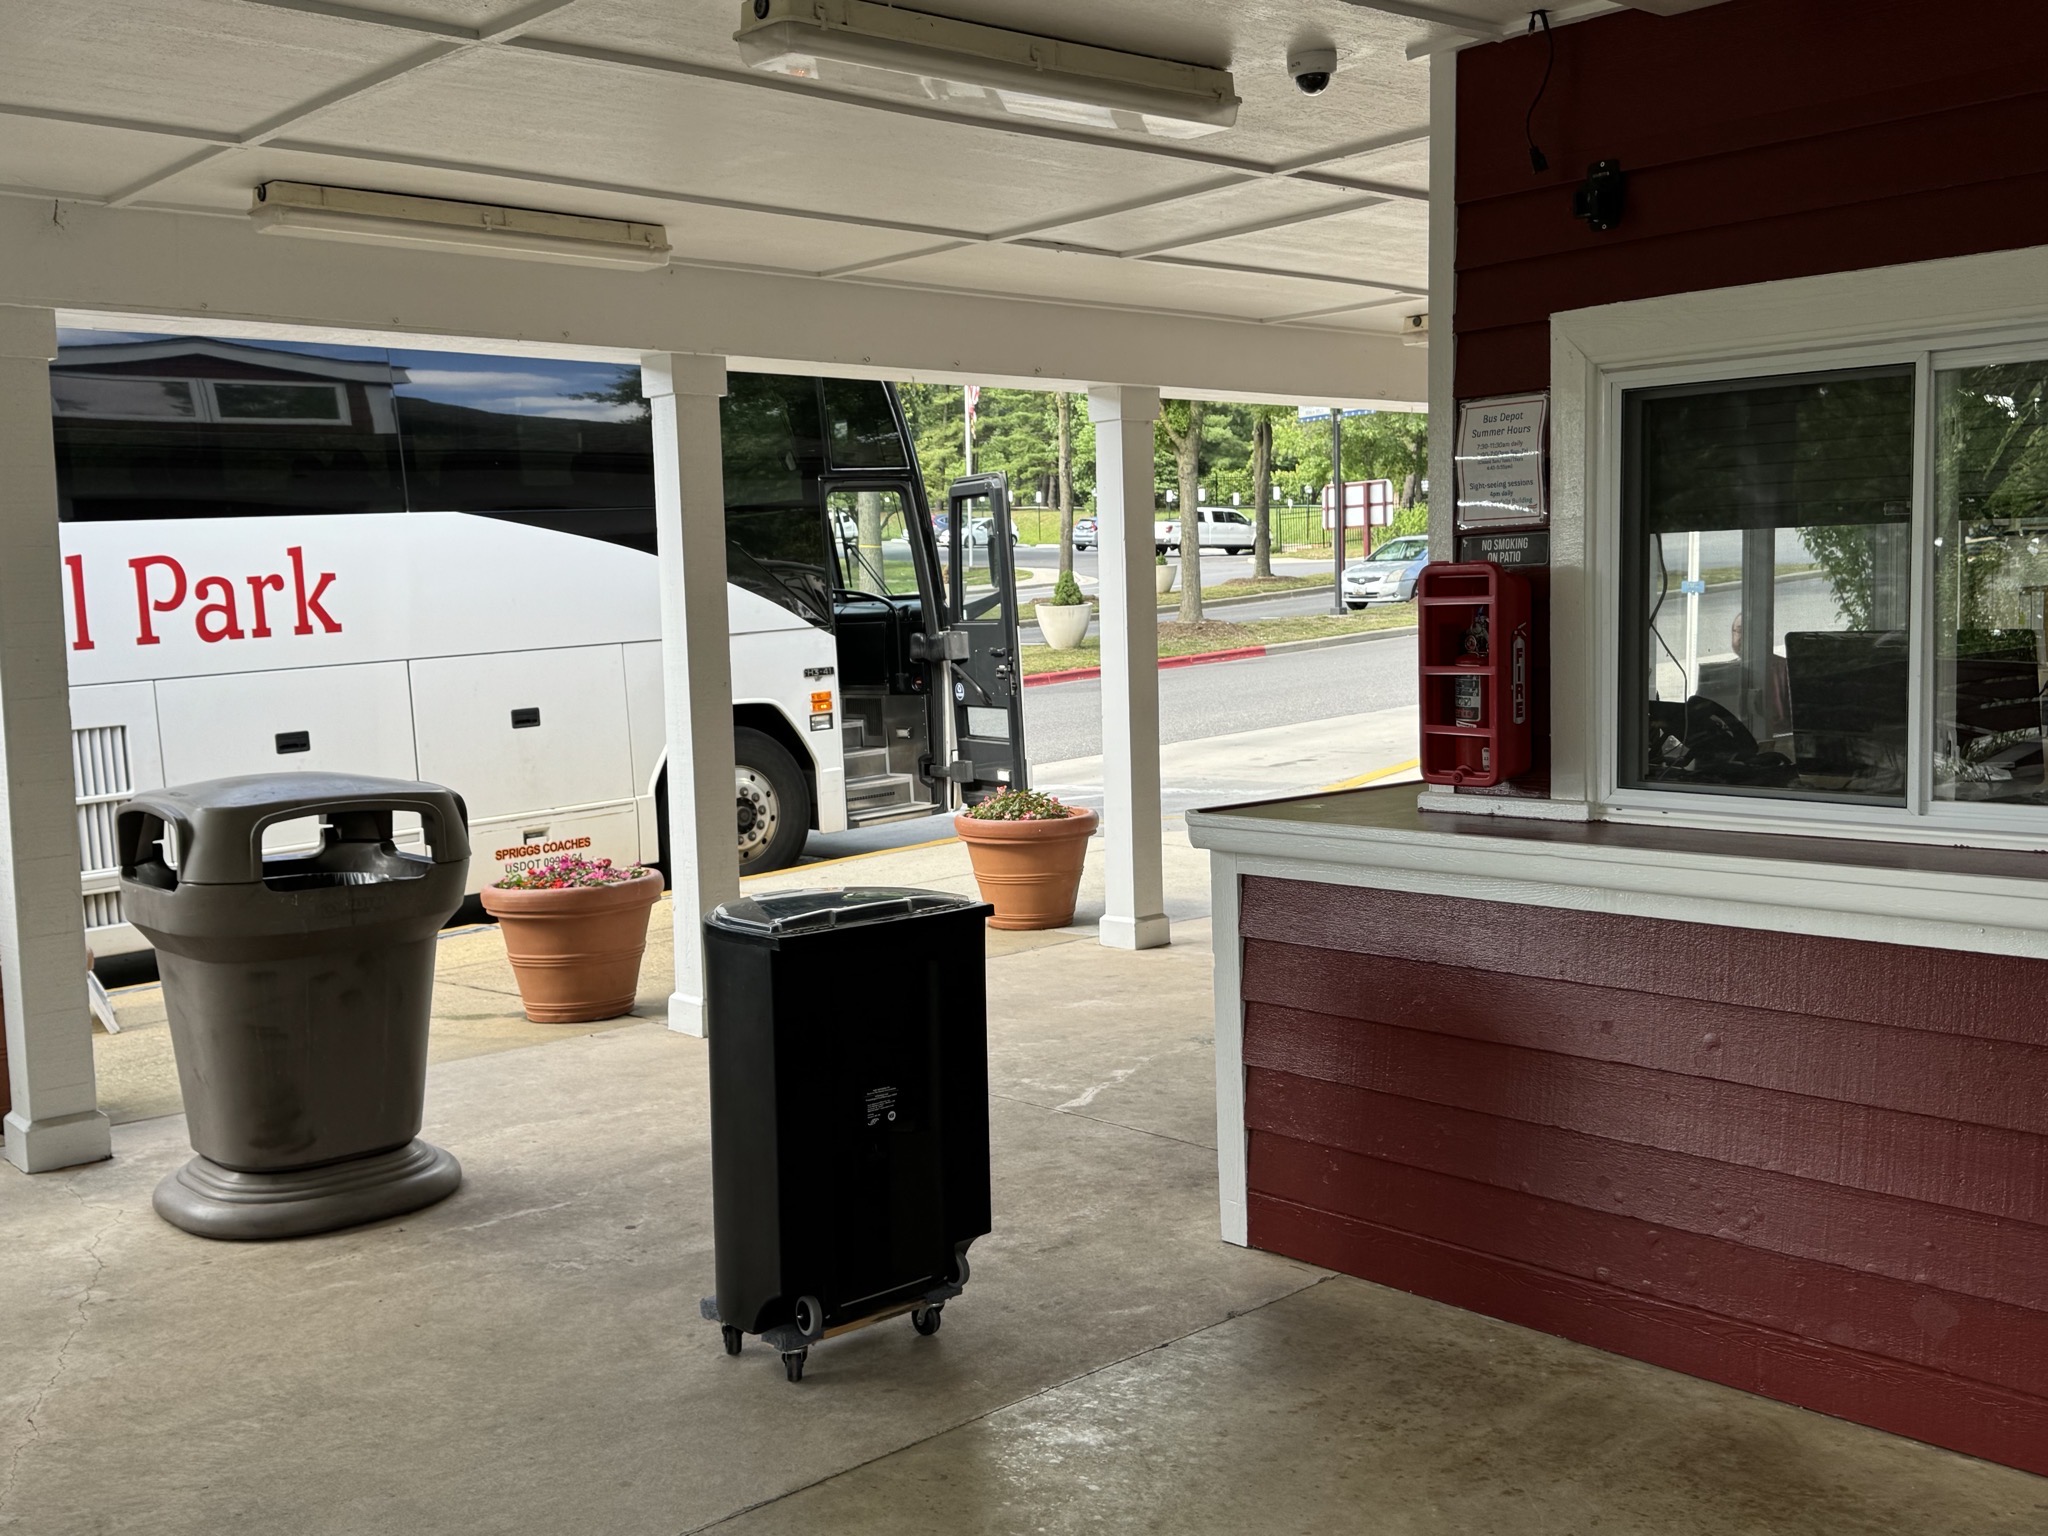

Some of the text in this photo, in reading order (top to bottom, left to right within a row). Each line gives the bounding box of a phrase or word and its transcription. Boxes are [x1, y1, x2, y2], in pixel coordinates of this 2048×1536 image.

[1483, 412, 1524, 424] Bus Depot
[1472, 425, 1532, 439] Summer Hours
[1511, 440, 1523, 448] daily
[1469, 481, 1507, 491] Sight-seeing
[1481, 537, 1529, 552] NO SMOKING
[1488, 550, 1522, 563] ON PATIO
[128, 546, 343, 646] Park
[1515, 647, 1524, 719] FIRE
[495, 837, 591, 861] SPRIGGS COACHES
[505, 859, 541, 874] USDOT
